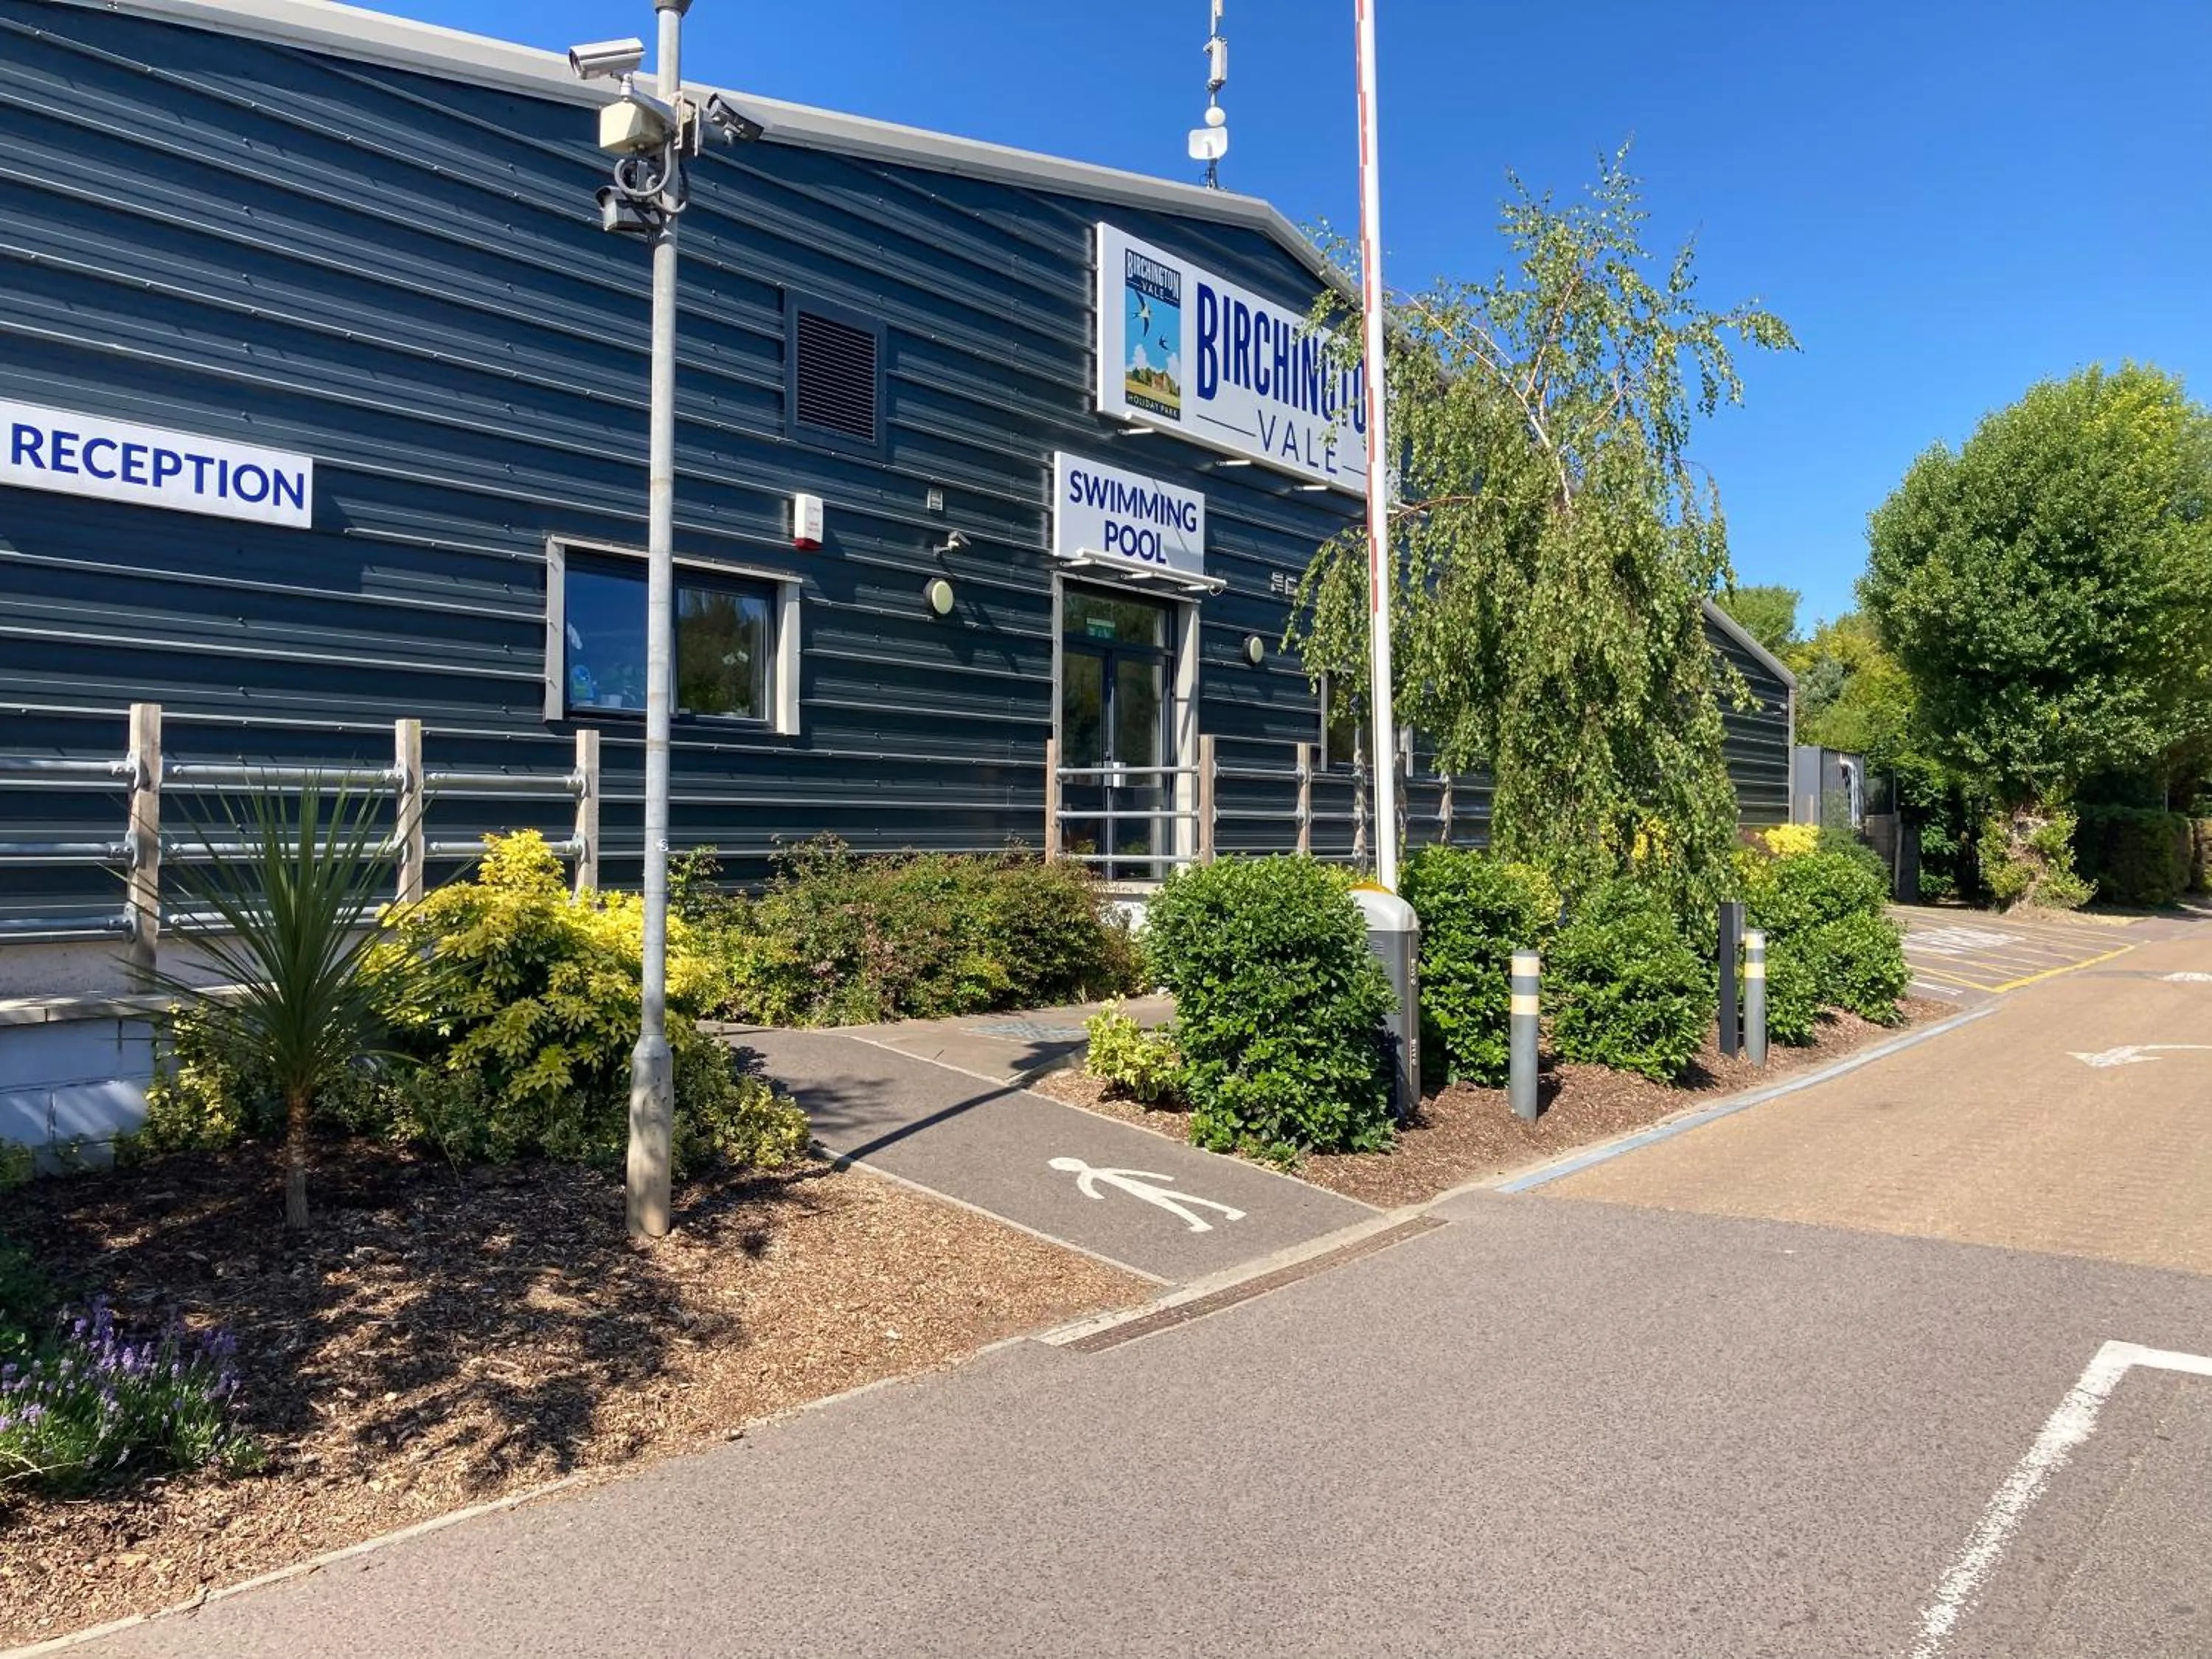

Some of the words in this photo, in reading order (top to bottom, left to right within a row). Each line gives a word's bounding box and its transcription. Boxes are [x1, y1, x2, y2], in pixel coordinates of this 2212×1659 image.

[1127, 251, 1179, 299] BIRCHINGTON
[1141, 282, 1164, 299] VALE
[1197, 282, 1368, 434] BIRCHINGTO
[11, 422, 305, 509] RECEPTION
[1258, 409, 1338, 474] VALE
[1069, 470, 1197, 533] SWIMMING
[1105, 520, 1166, 564] POOL
